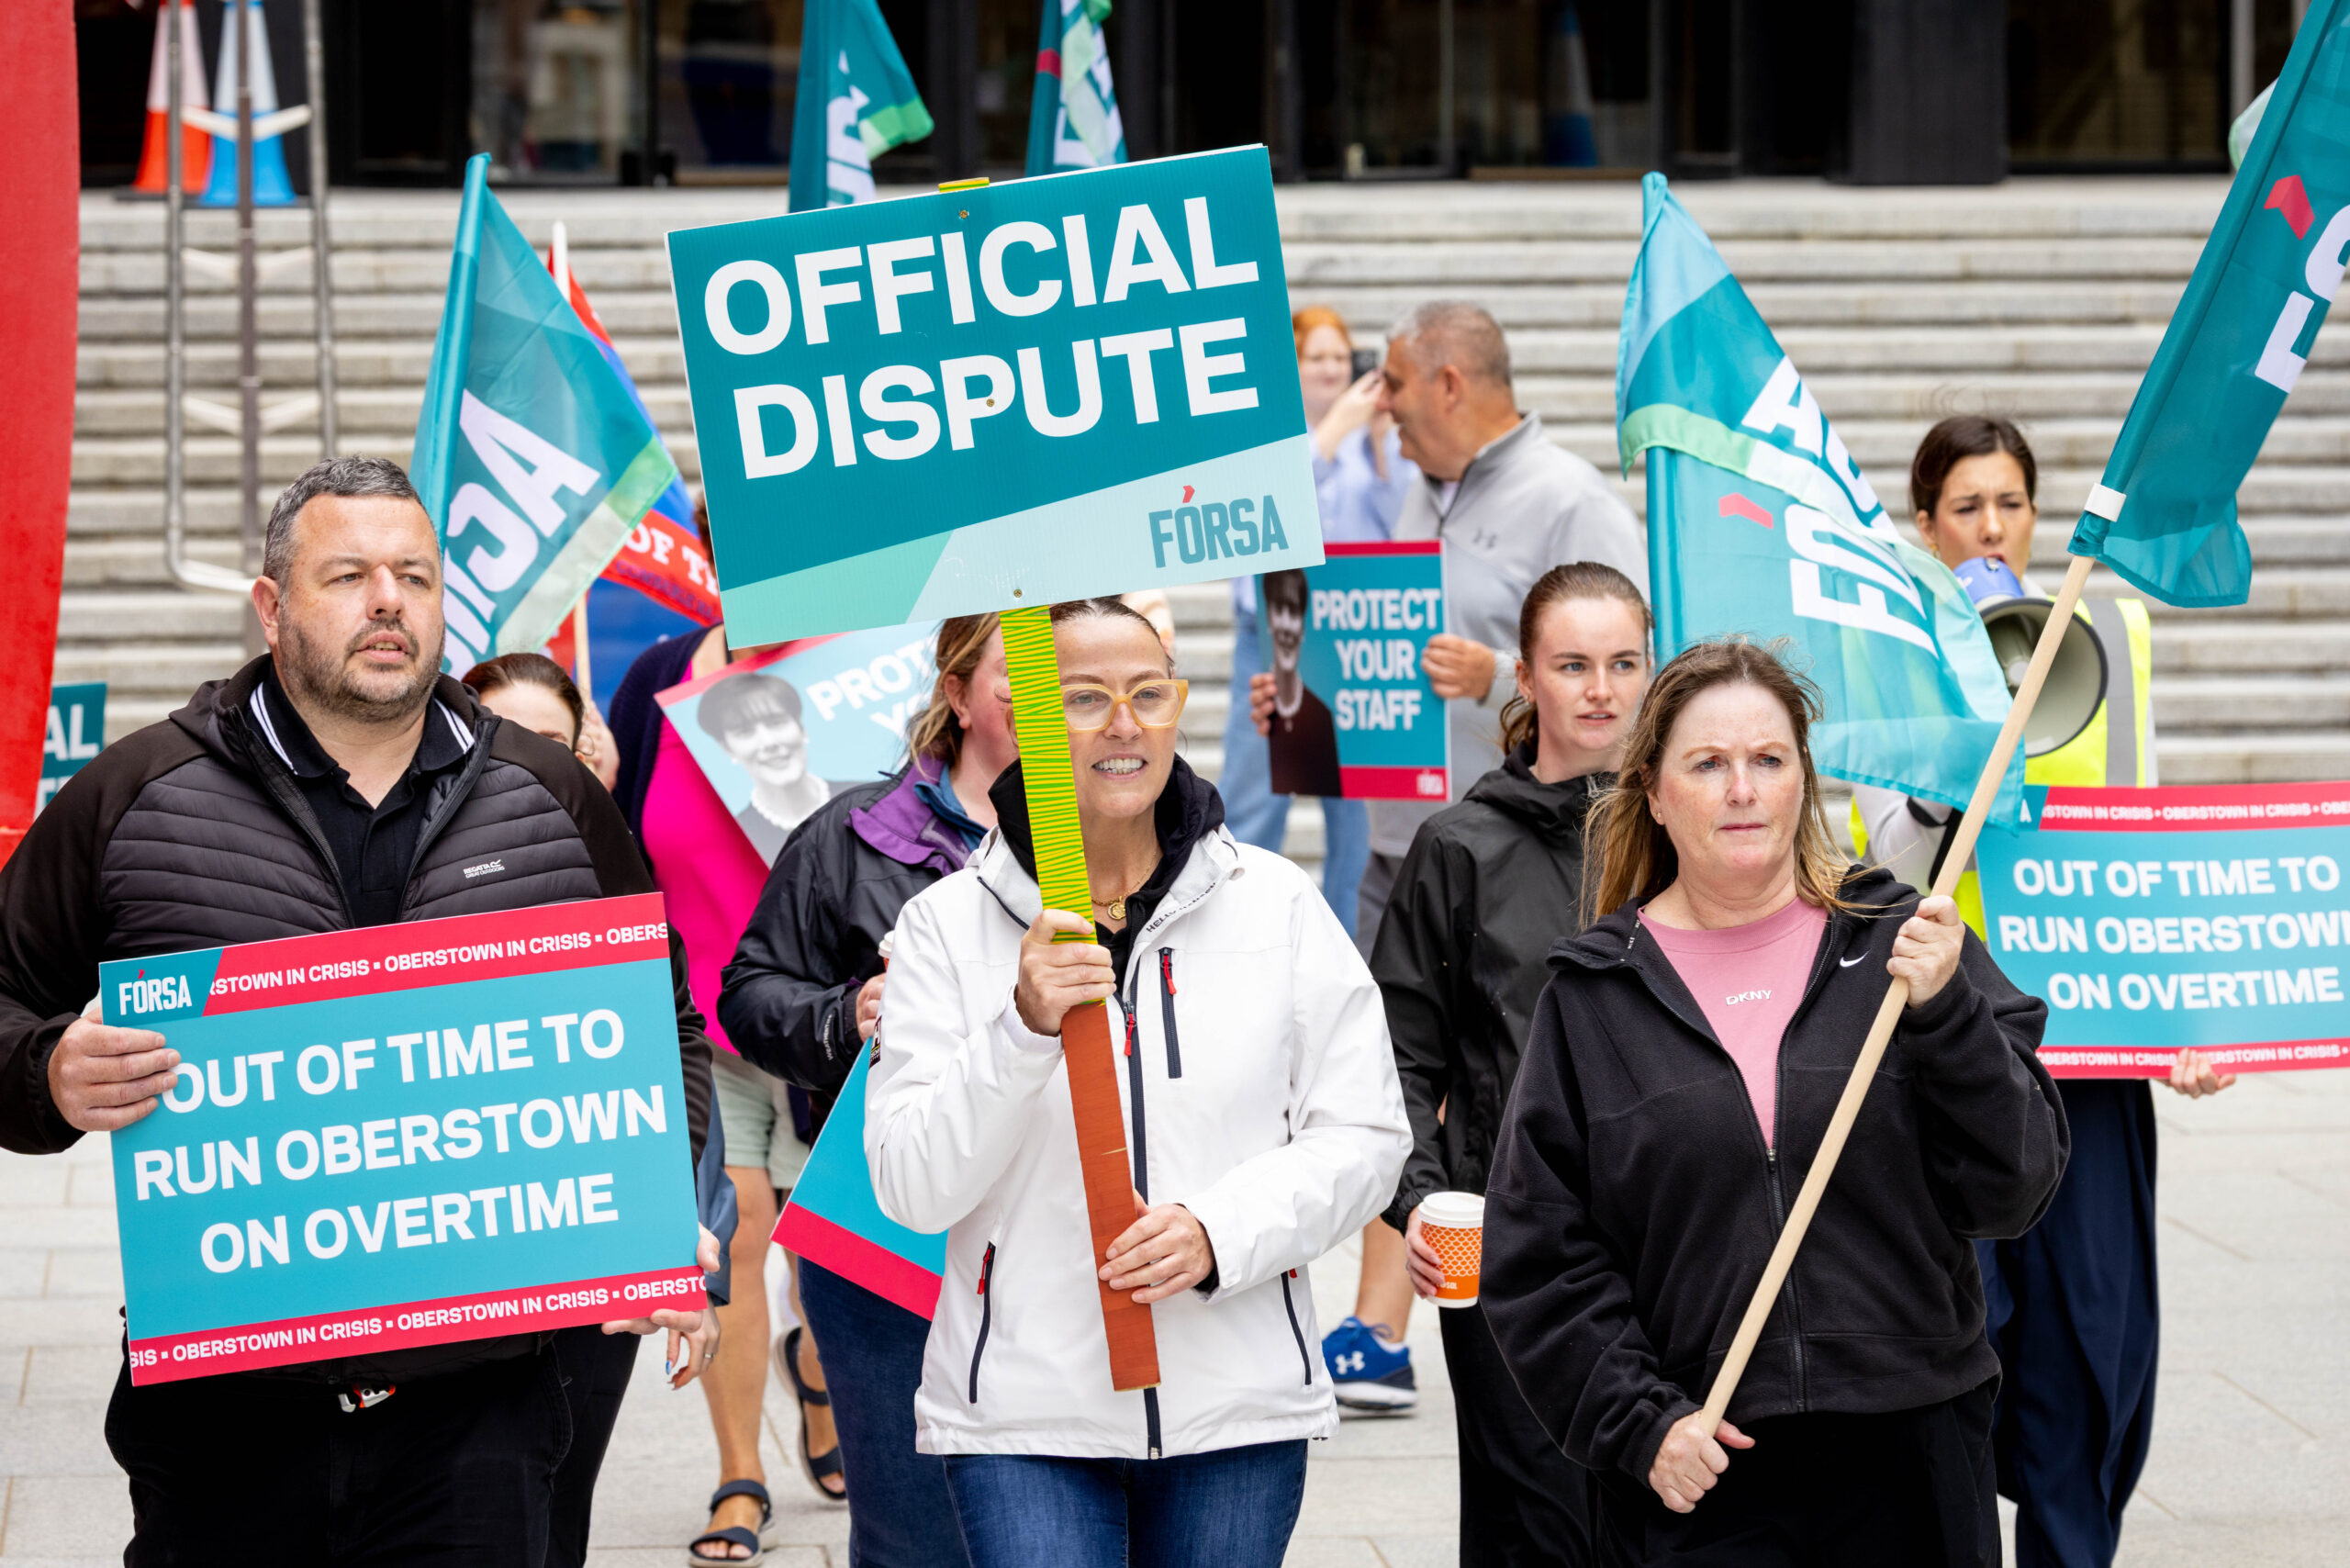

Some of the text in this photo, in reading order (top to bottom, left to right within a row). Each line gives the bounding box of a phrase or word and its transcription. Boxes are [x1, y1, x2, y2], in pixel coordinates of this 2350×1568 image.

[704, 196, 1259, 356] OFFICIAL
[733, 317, 1259, 479] DISPUTE
[1148, 485, 1289, 568] FÓRSA
[1312, 588, 1441, 631] PROTECT
[805, 634, 938, 722] PROT
[1335, 640, 1416, 681] YOUR
[1335, 689, 1422, 731] STAFF
[2094, 806, 2109, 819] IN
[2109, 806, 2154, 820] CRISIS
[2163, 805, 2248, 820] OBERSTOWN
[2249, 804, 2265, 818] IN
[2266, 802, 2311, 817] CRISIS
[2013, 855, 2341, 897] OUT OF TIME TO
[1998, 915, 2088, 953] RUN
[286, 968, 307, 985] IN
[308, 959, 369, 982] CRISIS
[385, 942, 503, 973] OBERSTOWN
[507, 940, 526, 957] IN
[530, 932, 591, 954] CRISIS
[119, 969, 192, 1015] FÓRSA
[1726, 990, 1772, 1006] DKNY
[2048, 967, 2344, 1011] ON OVERTIME
[162, 1009, 624, 1114] OUT OF TIME TO
[2294, 1044, 2340, 1059] CRISIS
[134, 1085, 667, 1201] RUN OBERSTOWN
[200, 1173, 619, 1273] ON OVERTIME
[173, 1330, 293, 1361] OBERSTOWN
[297, 1327, 316, 1344] IN
[319, 1317, 383, 1341] CRISIS
[397, 1300, 519, 1330] OBERSTOWN
[522, 1296, 543, 1314] IN
[545, 1288, 609, 1311] CRISIS
